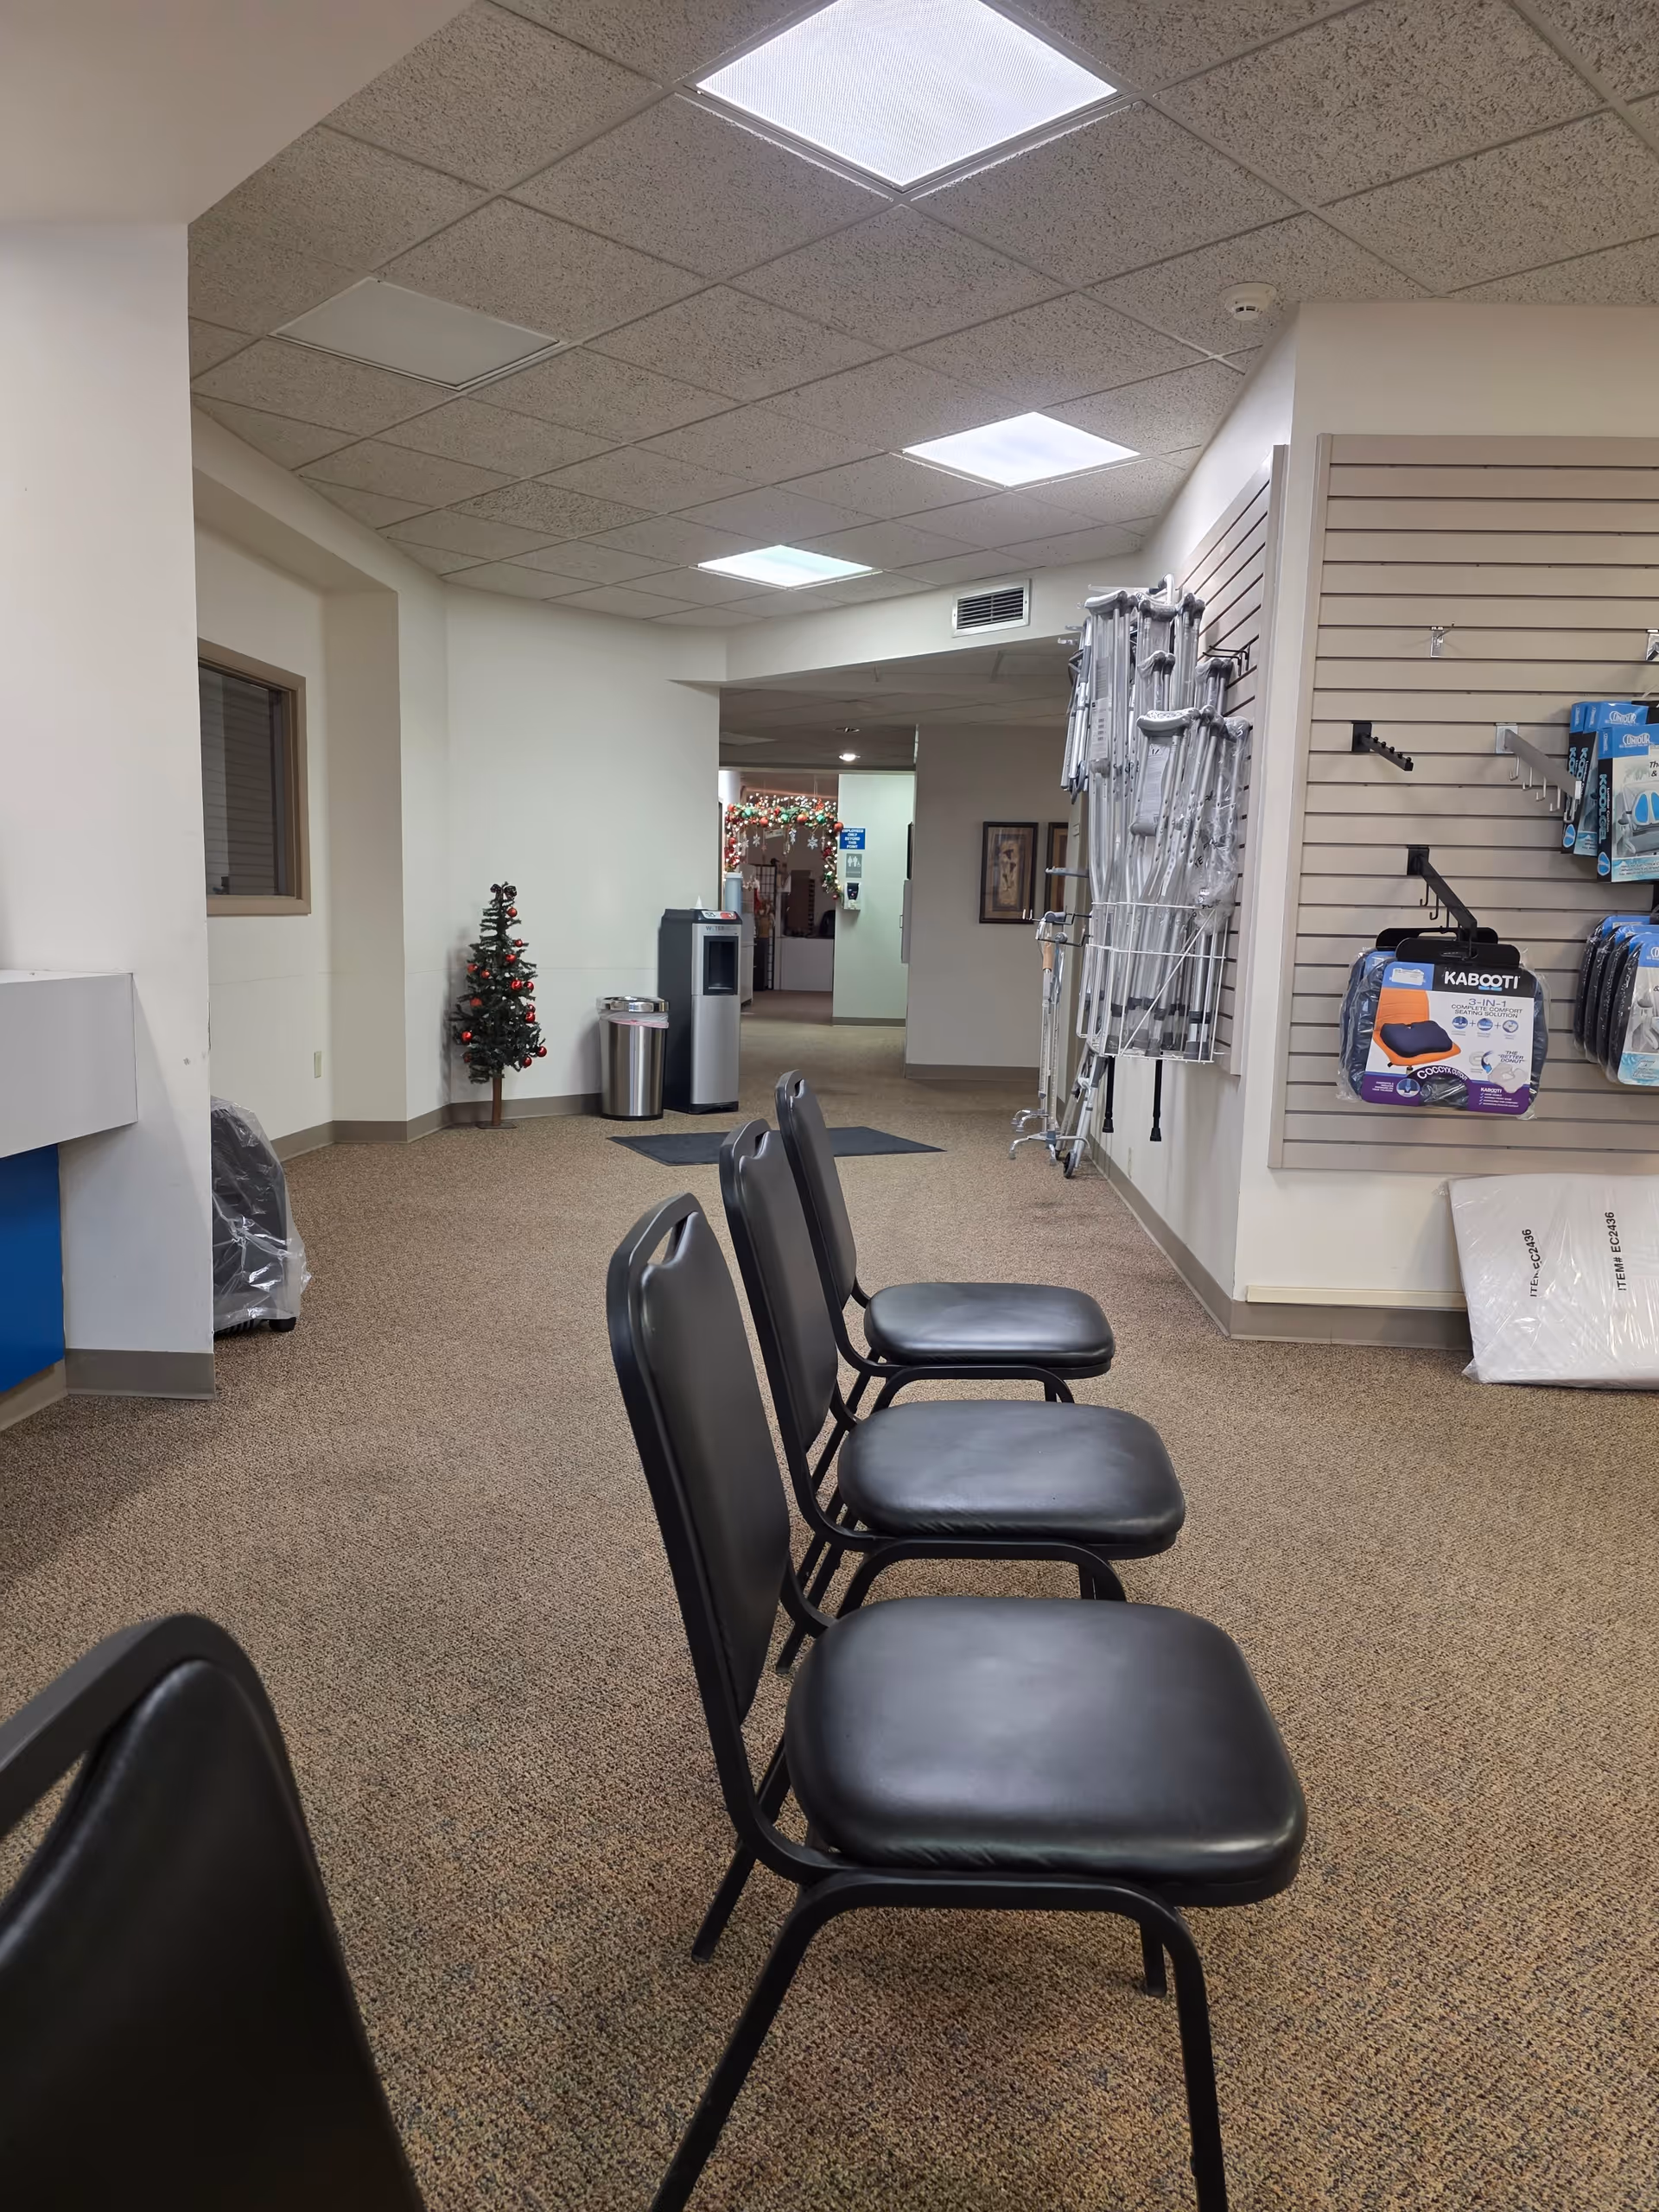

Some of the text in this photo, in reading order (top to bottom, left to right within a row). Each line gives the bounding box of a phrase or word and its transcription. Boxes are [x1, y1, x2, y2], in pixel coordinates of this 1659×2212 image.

[1444, 970, 1518, 989] KABOOTI
[1468, 998, 1507, 1007] 3-IN-1
[1417, 1066, 1468, 1081] COCCYX CUTOUT
[1605, 1211, 1627, 1291] ITEM# EC2436
